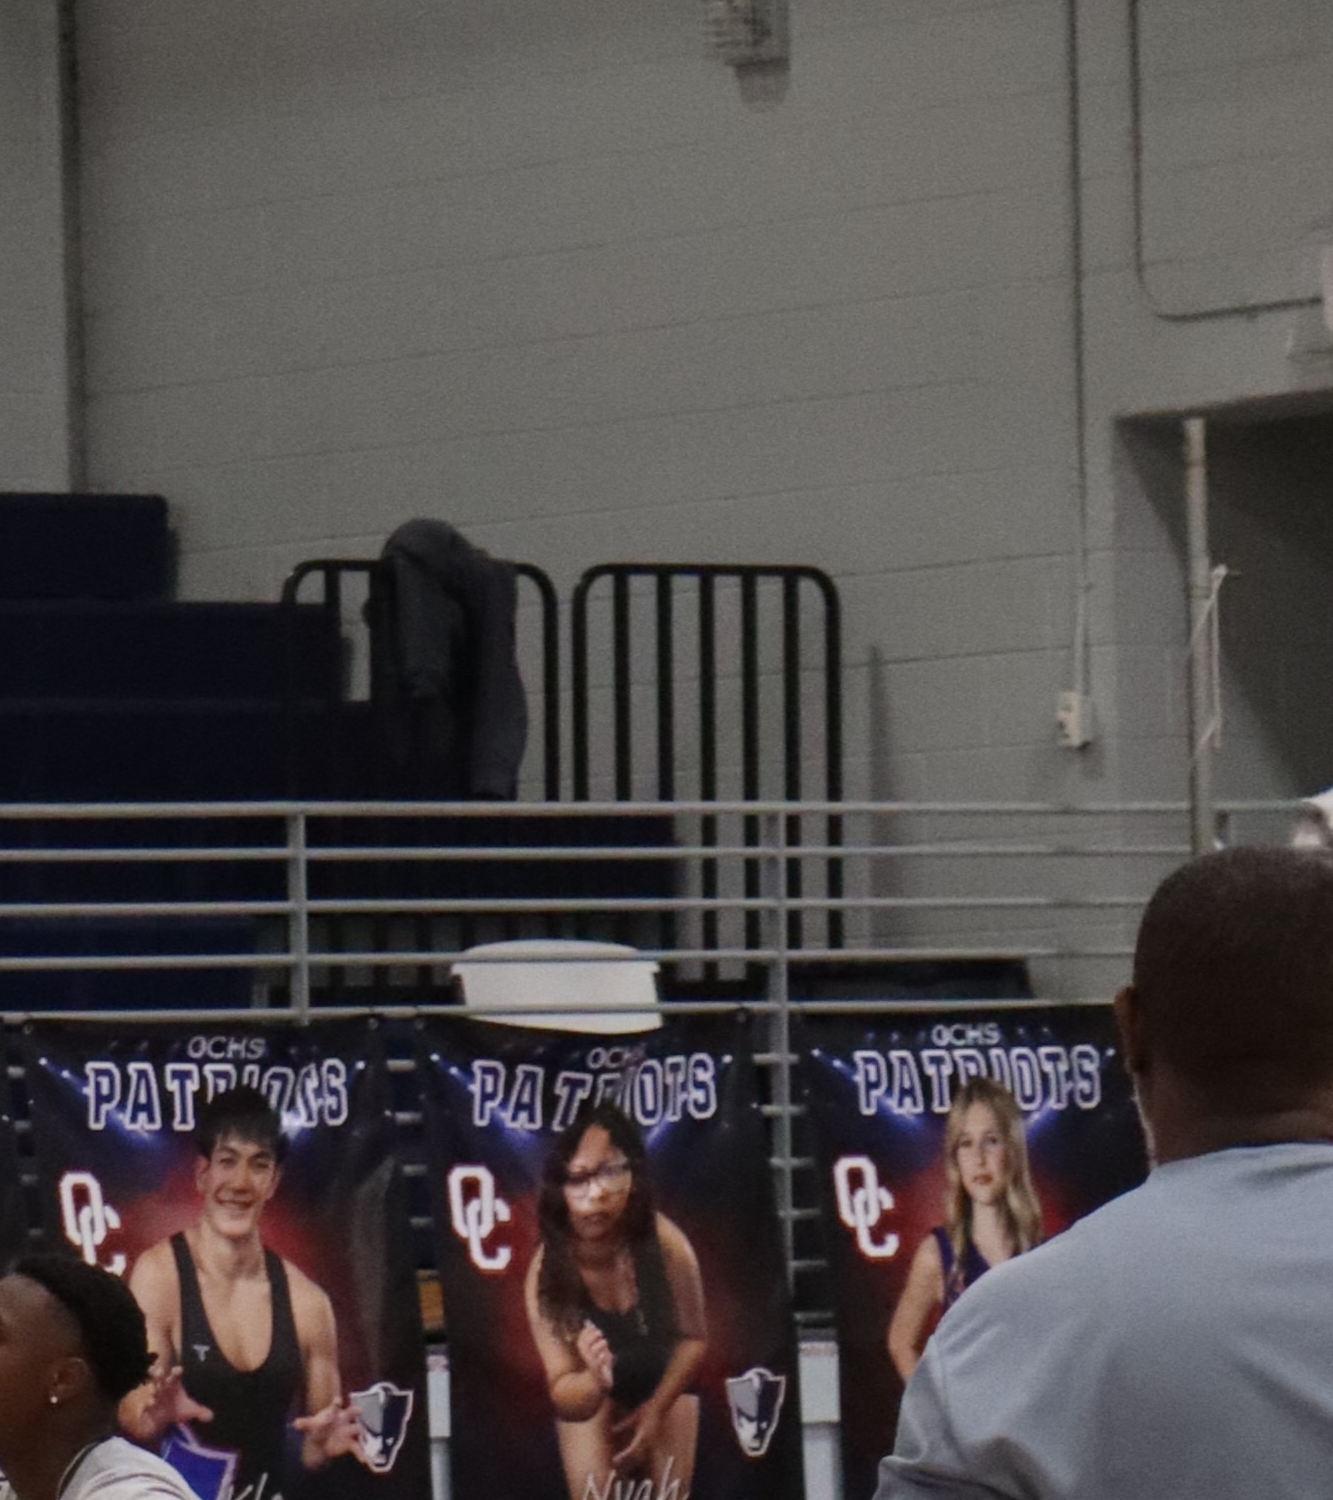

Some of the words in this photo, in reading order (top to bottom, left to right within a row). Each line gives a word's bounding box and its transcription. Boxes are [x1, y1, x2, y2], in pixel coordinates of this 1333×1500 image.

[187, 1035, 266, 1060] OCHS
[931, 1021, 1000, 1047] OCHS
[447, 1164, 512, 1271] OC
[832, 1155, 900, 1258] OC
